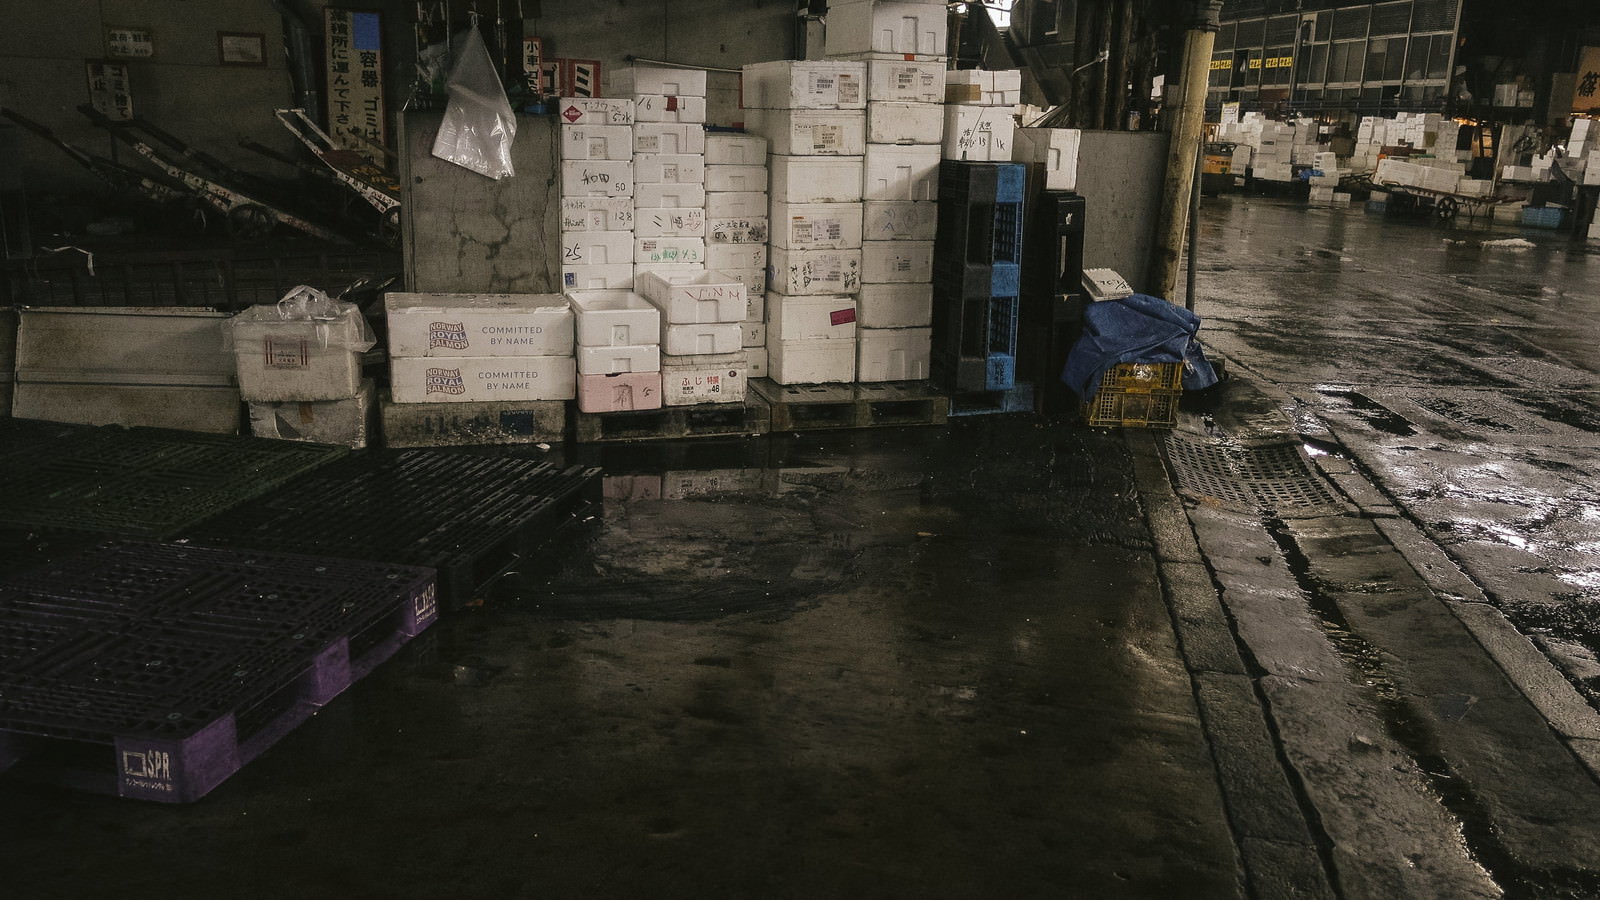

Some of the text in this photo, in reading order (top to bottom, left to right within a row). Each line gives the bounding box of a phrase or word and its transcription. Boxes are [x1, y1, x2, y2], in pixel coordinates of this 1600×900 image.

[615, 182, 626, 192] 50
[564, 243, 582, 261] 25
[429, 321, 464, 332] NORWAY
[481, 326, 543, 335] COMMITTED
[430, 330, 467, 342] ROYAL
[429, 339, 469, 350] SALMON
[490, 337, 535, 346] BY NAME
[426, 367, 461, 377] NORWAY
[478, 371, 538, 380] COMMITTED
[426, 376, 463, 386] ROYAL
[502, 382, 530, 390] NAME
[426, 384, 466, 395] SALMON
